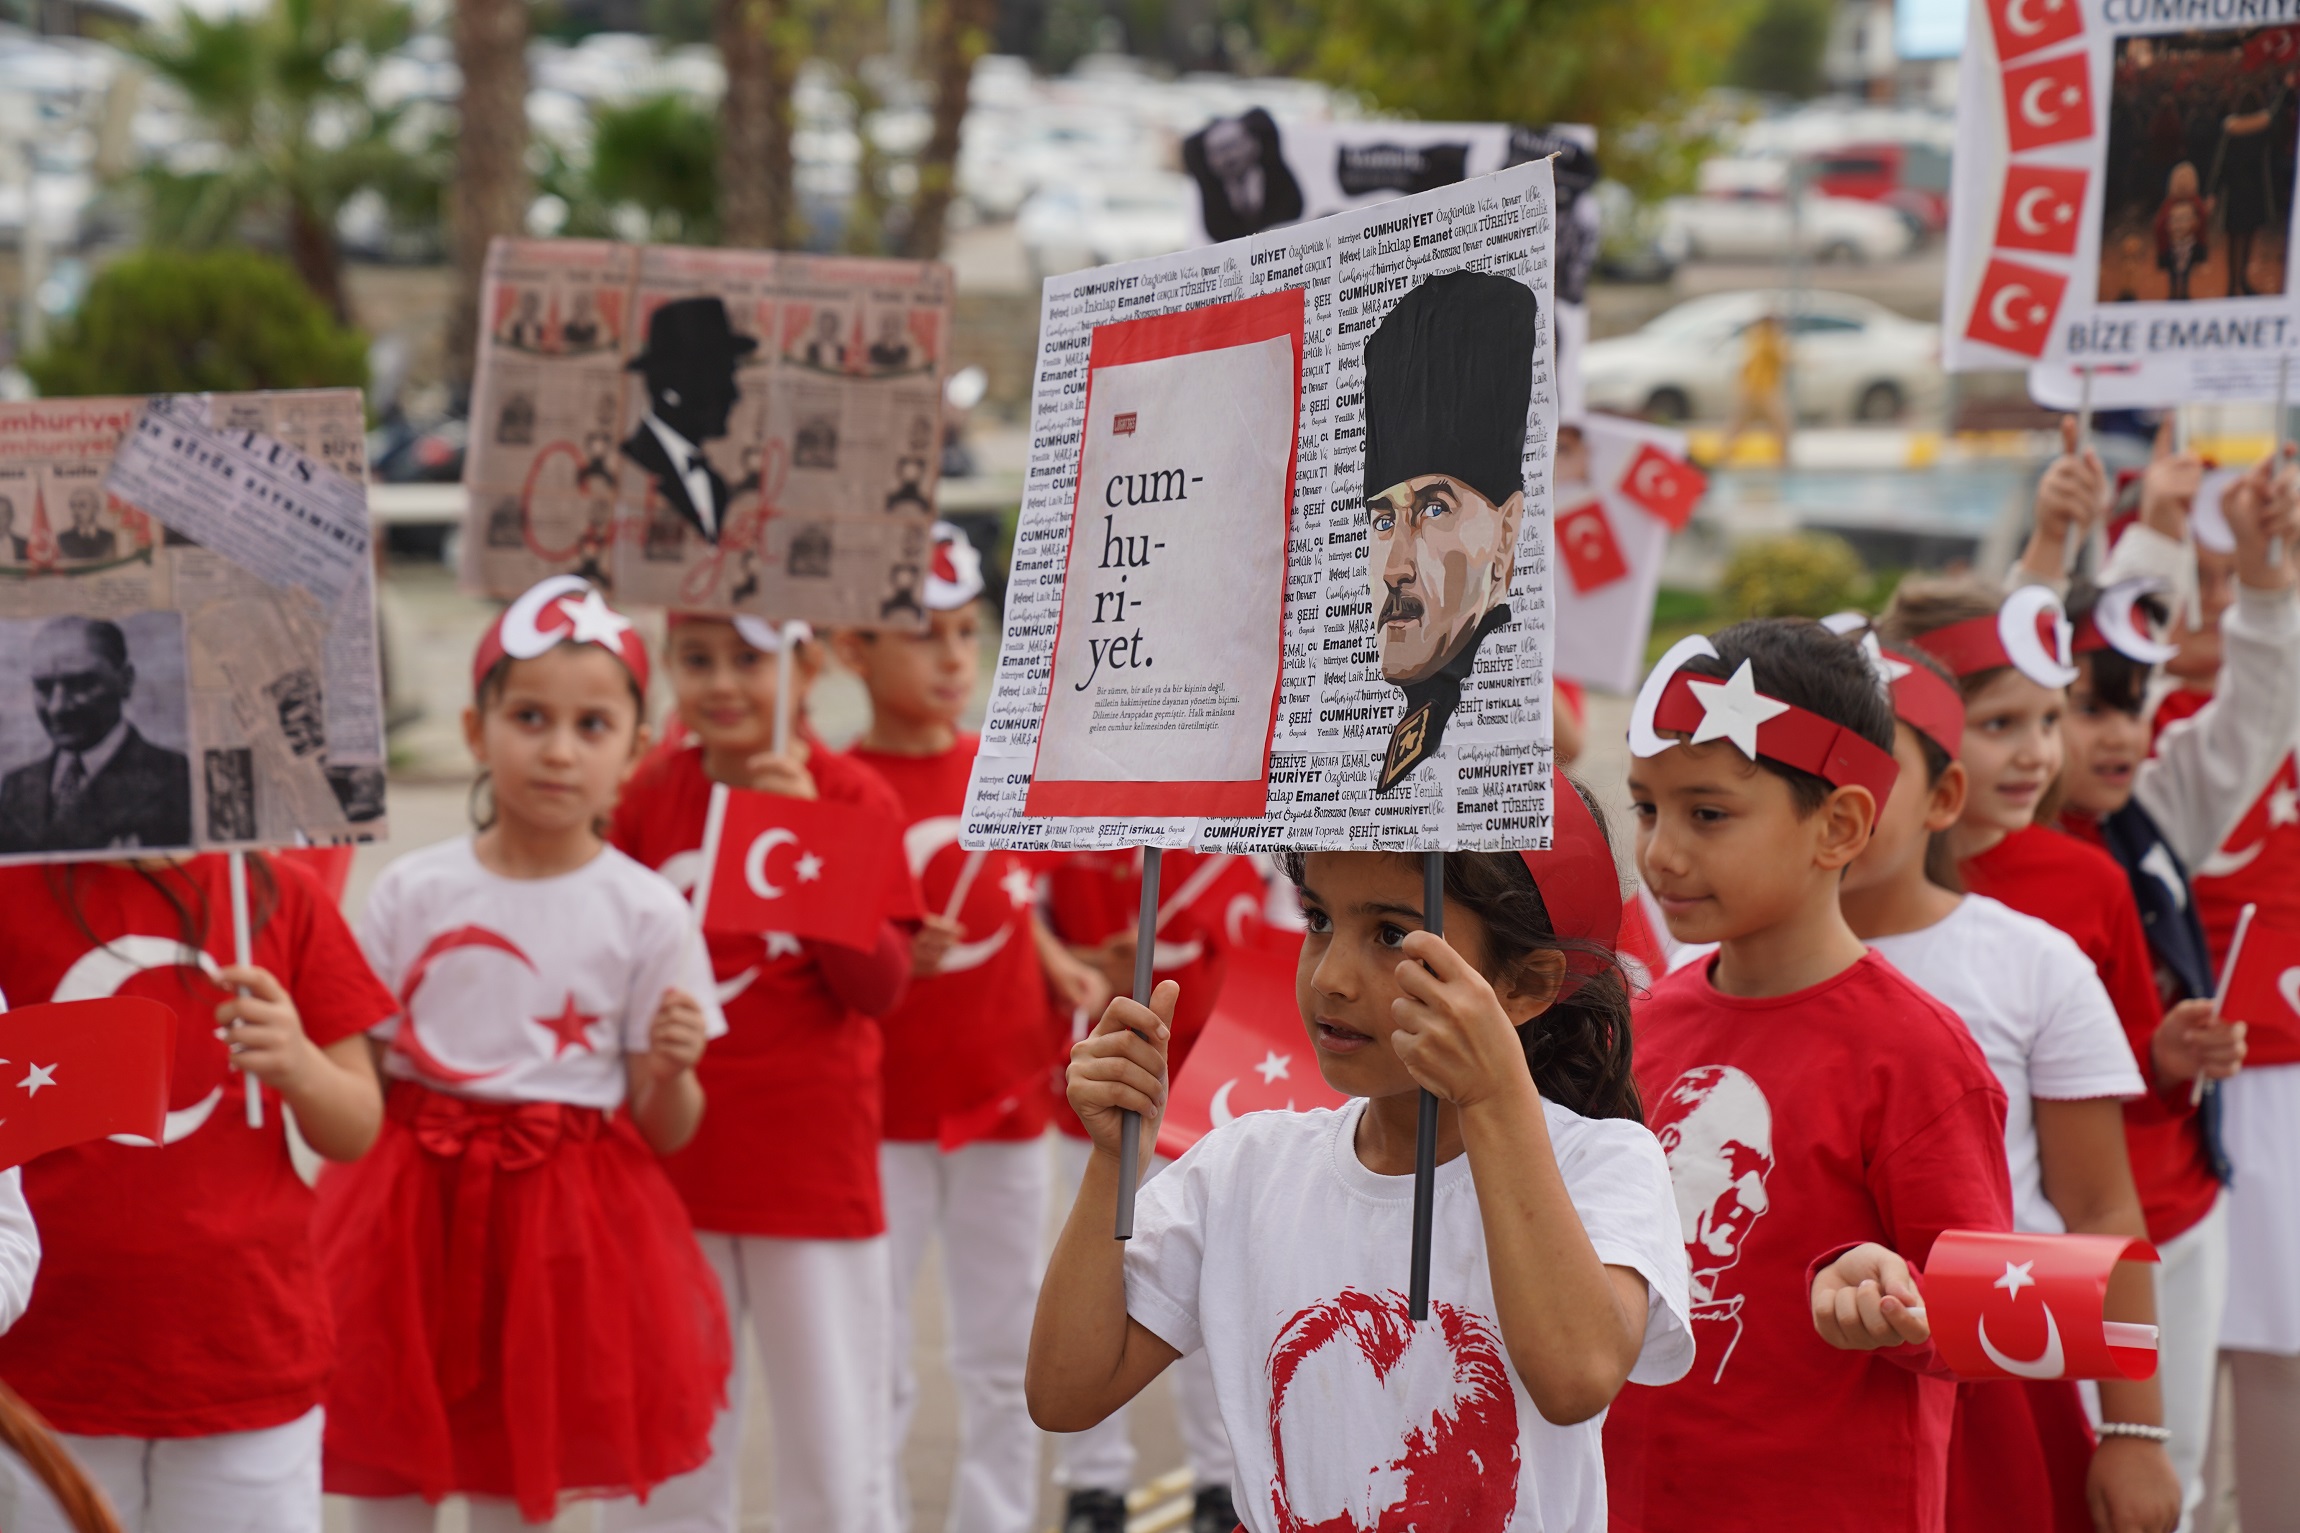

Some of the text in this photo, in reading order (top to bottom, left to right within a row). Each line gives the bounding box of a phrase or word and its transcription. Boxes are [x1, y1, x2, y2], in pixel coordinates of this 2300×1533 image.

[1338, 232, 1361, 244] hürriyet
[1363, 211, 1434, 239] CUMHURİYET
[1436, 203, 1475, 225] Özgürlük
[1478, 197, 1499, 212] Vatan
[1363, 246, 1377, 258] Laik
[1378, 238, 1411, 256] İnkılap
[1413, 227, 1453, 248] Emanet
[1479, 209, 1519, 232] TÜRKİYE
[1520, 199, 1548, 221] Yenilik
[1289, 241, 1324, 260] Özgürlük
[1376, 260, 1404, 277] hürriyet
[1486, 226, 1536, 247] CUMHURİYET
[1268, 262, 1304, 281] Emanet
[1533, 259, 1547, 271] Laik
[1339, 250, 1528, 302] CUMHURİYET İSTİKLAL
[1073, 277, 1139, 298] CUMHURİYET
[1085, 270, 1243, 313] İnkılap Emanet TÜRKİYE Yenilik
[1338, 306, 1358, 317] Yenilik
[1338, 316, 1376, 335] Emanet
[2068, 314, 2297, 354] BİZE EMANET.
[1337, 341, 1361, 351] hürriyet
[1041, 369, 1077, 382] Emanet
[1534, 374, 1547, 385] Laik
[0, 412, 131, 433] mhuriyet
[1335, 413, 1355, 423] Yenilik
[1334, 427, 1365, 440] Emane
[1334, 445, 1357, 456] hürriyet
[1031, 464, 1065, 477] Emanet
[1105, 466, 1204, 508] cum-
[1532, 484, 1545, 497] Laik
[1527, 503, 1545, 517] Vatan
[1329, 517, 1349, 527] Yenilik
[1098, 514, 1166, 569] hu-
[1329, 528, 1367, 544] Emanet
[1328, 552, 1352, 561] hürriyet
[1517, 542, 1544, 558] Yenilik
[1016, 558, 1053, 571] Emanet
[1352, 566, 1367, 577] Laik
[1092, 574, 1142, 624] ri-
[1530, 599, 1545, 611] Laik
[1325, 602, 1373, 618] CUMHUR
[1324, 619, 1368, 634] Yenilik MARŞ
[1524, 616, 1545, 631] Vatan
[1323, 636, 1362, 651] Emanet
[1002, 655, 1040, 666] Emanet
[1075, 627, 1153, 692] yet.
[1323, 656, 1348, 666] hürriyet
[1515, 653, 1543, 669] Yenilik
[1348, 671, 1364, 683] Laik
[1478, 675, 1530, 690] CUMHURİYET
[1096, 683, 1225, 695] Bir zümre, bir aile ya da bir kişinin değil,
[1361, 687, 1392, 704] hürriyet
[1095, 696, 1240, 708] milletin hakimiyetine dayanan yönetim biçimi.
[1486, 696, 1522, 709] İSTİKLAL
[1093, 710, 1118, 720] Dilimize
[1120, 711, 1153, 720] Arapçadan
[1154, 710, 1186, 720] geçmiştir.
[1188, 709, 1204, 718] Halk
[1320, 704, 1394, 722] CUMHURİYET
[1477, 713, 1508, 726] Sonsuza
[1527, 710, 1541, 721] Laik
[1089, 720, 1220, 734] gelen cumhur kelimesinden türetilmiştir.
[1318, 725, 1365, 740] Yenilik MARŞ
[1500, 745, 1530, 759] hürriyet
[1458, 761, 1534, 780] CUMHURİYET
[1325, 770, 1367, 787] Özgürlük
[1002, 791, 1016, 801] Laik
[1296, 782, 1443, 802] Emanet Yenilik
[1457, 781, 1546, 797] Yenilik MARŞ ATATÜRK
[1284, 807, 1312, 822] Özgürlük
[1314, 806, 1347, 818] Sonsuza
[1375, 804, 1428, 816] CUMHURİYET
[1457, 797, 1545, 814] Emanet TÜRKİYE
[1457, 812, 1549, 832] hürriyet CUMHURİY
[968, 822, 1042, 835] CUMHURİYET
[1098, 822, 1128, 838] ŞEHİT
[1129, 824, 1165, 834] İSTİKLAL
[1204, 824, 1284, 838] CUMHURİYET
[1287, 827, 1313, 839] BAYRAM
[1315, 827, 1344, 838] Toprak
[1349, 822, 1380, 840] ŞEHİT
[1382, 824, 1419, 836] İSTİKLAL
[964, 840, 1049, 850] Yenilik ATATÜRK
[1200, 839, 1440, 853] Yenilik ATATÜRK Laik
[1484, 834, 1537, 850] Laik İnkılap
